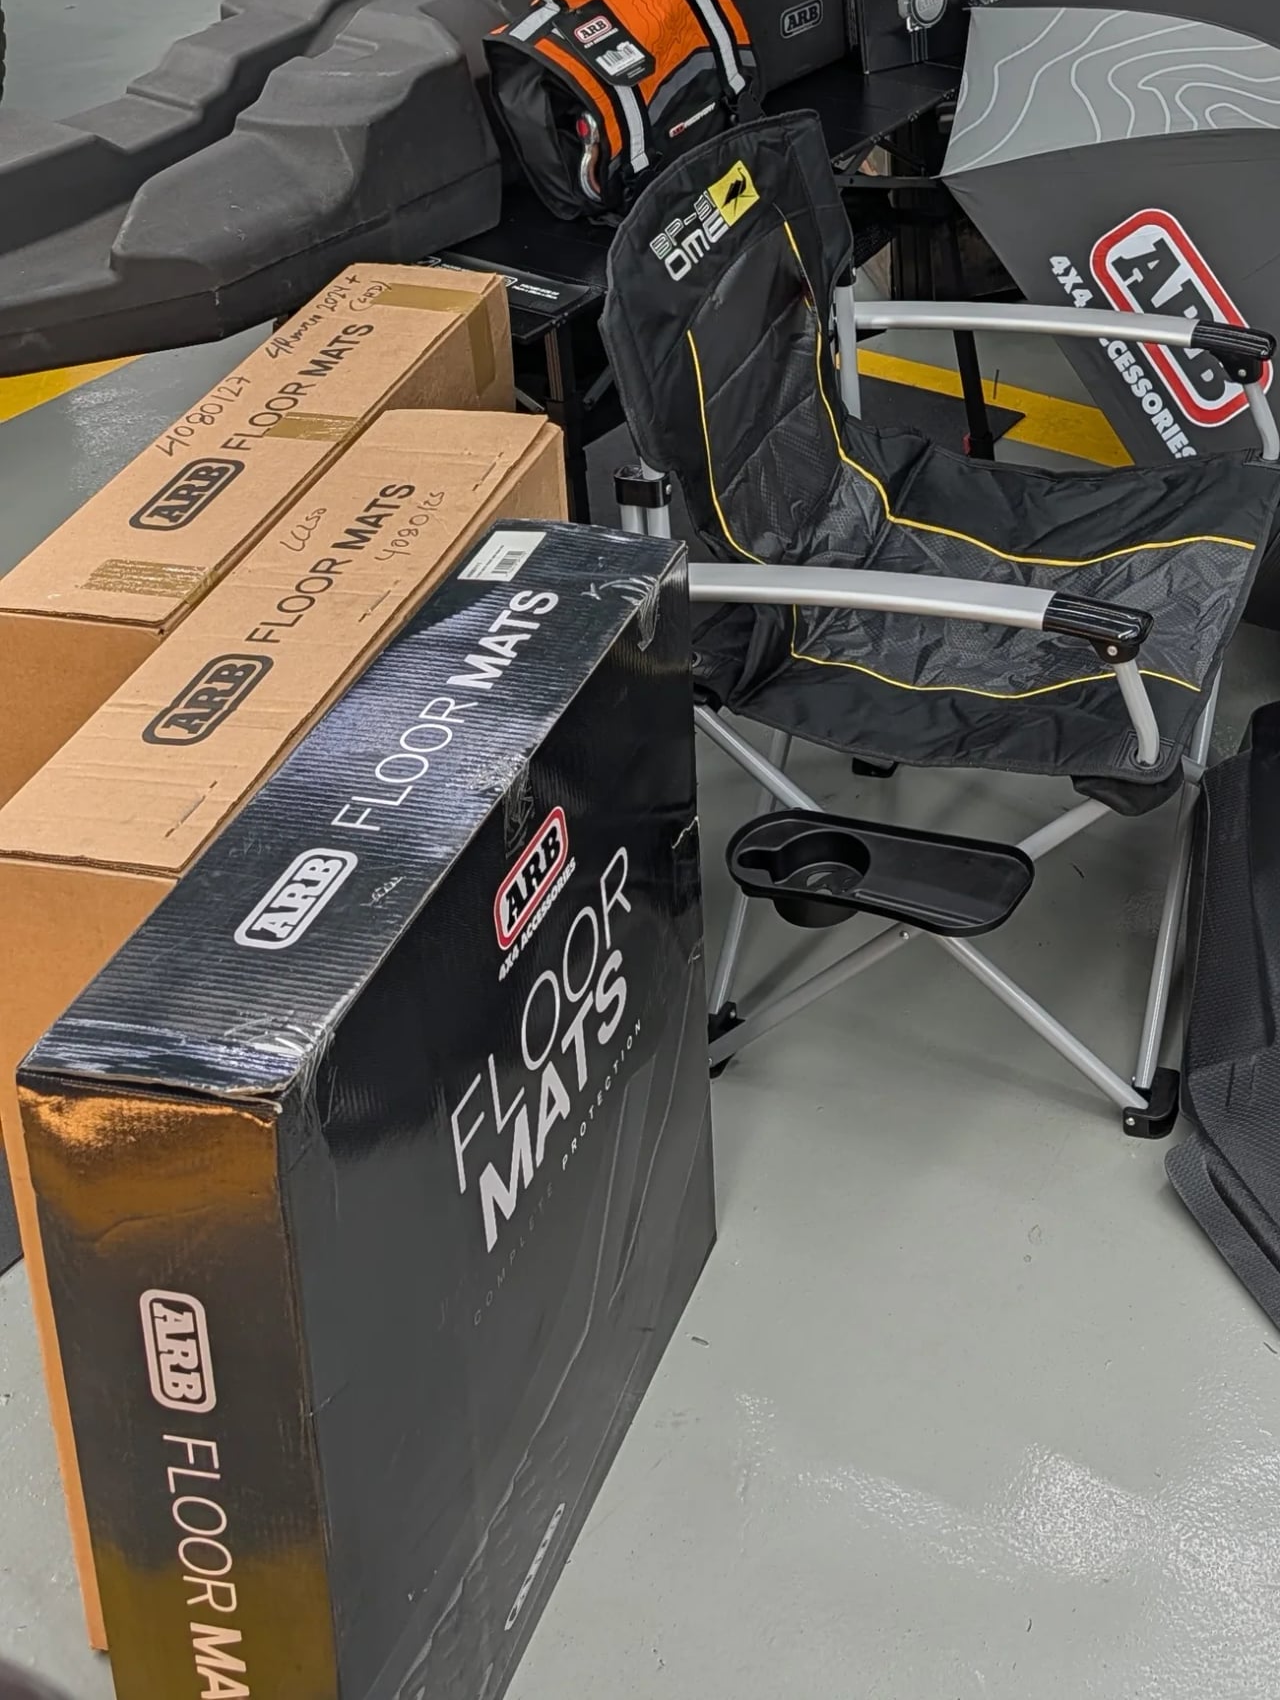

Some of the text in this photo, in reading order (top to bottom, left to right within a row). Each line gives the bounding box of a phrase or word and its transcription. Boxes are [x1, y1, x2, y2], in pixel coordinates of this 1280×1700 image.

[650, 190, 716, 260] BP-51
[664, 208, 730, 281] OME
[156, 376, 251, 457] 4080127
[220, 381, 317, 450] FLOOR
[297, 324, 375, 377] MATS
[1050, 255, 1197, 459] 4X4 CESSORIES
[245, 557, 352, 643] FLOOR
[331, 483, 416, 551] MATS
[331, 696, 478, 831] FLOOR
[447, 590, 559, 690] MATS
[499, 857, 577, 981] 4X4 ACCESSORIES
[503, 825, 561, 930] ARB
[451, 846, 632, 1194] FLOOR
[479, 949, 628, 1253] MATS
[562, 1018, 641, 1171] PROTECTION
[151, 1301, 202, 1400] ARB
[163, 1434, 238, 1613] FLOOR
